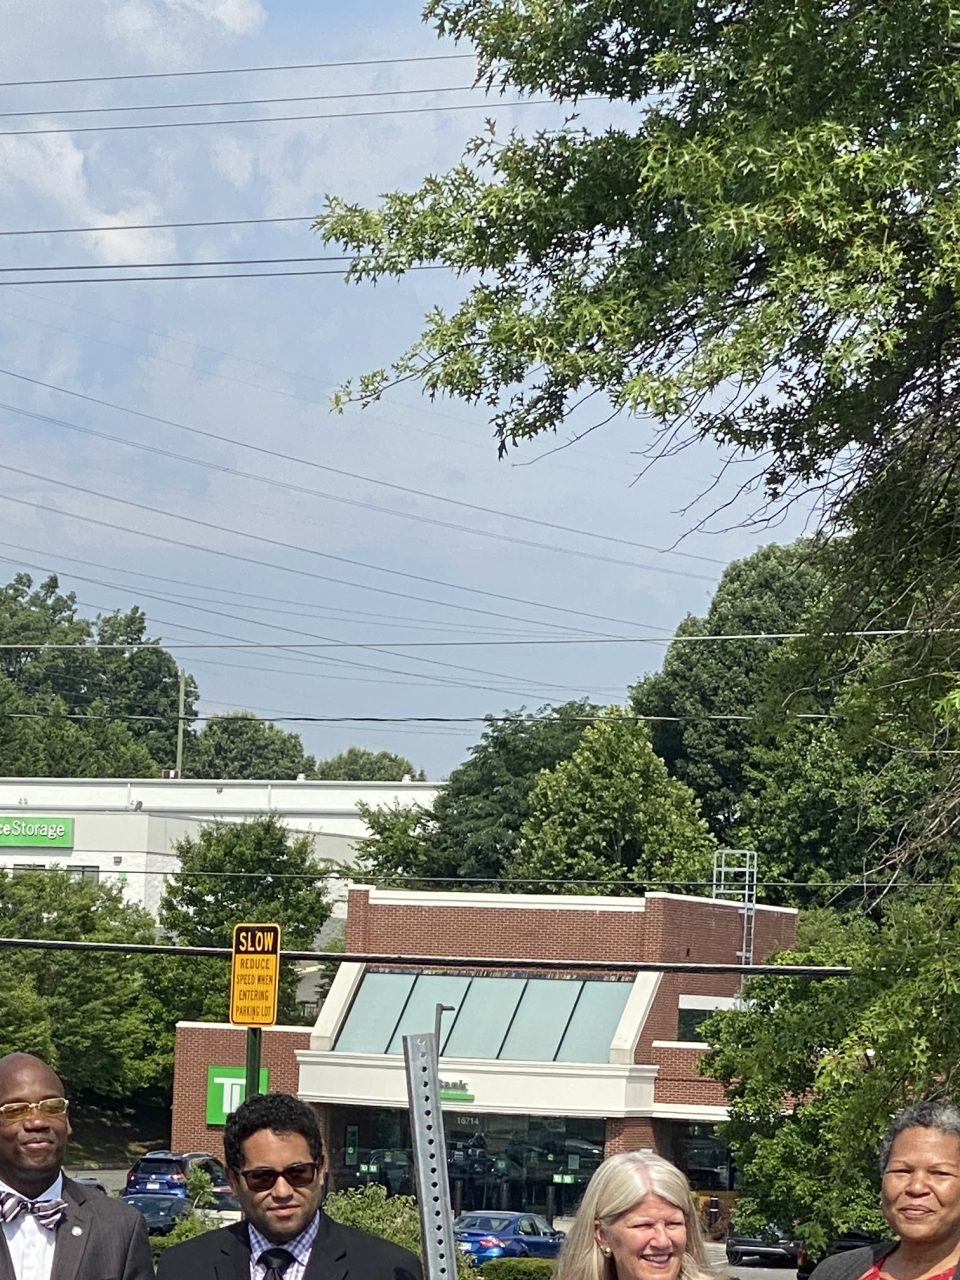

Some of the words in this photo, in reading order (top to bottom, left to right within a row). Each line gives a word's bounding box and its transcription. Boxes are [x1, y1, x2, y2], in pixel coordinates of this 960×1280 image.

[239, 931, 274, 952] SLOW
[240, 958, 270, 970] REDUCE
[236, 974, 255, 985] SPEED
[257, 974, 273, 986] WHEN
[239, 989, 269, 1001] ENTERING
[235, 1005, 259, 1017] PARKING
[261, 1005, 272, 1017] LOT
